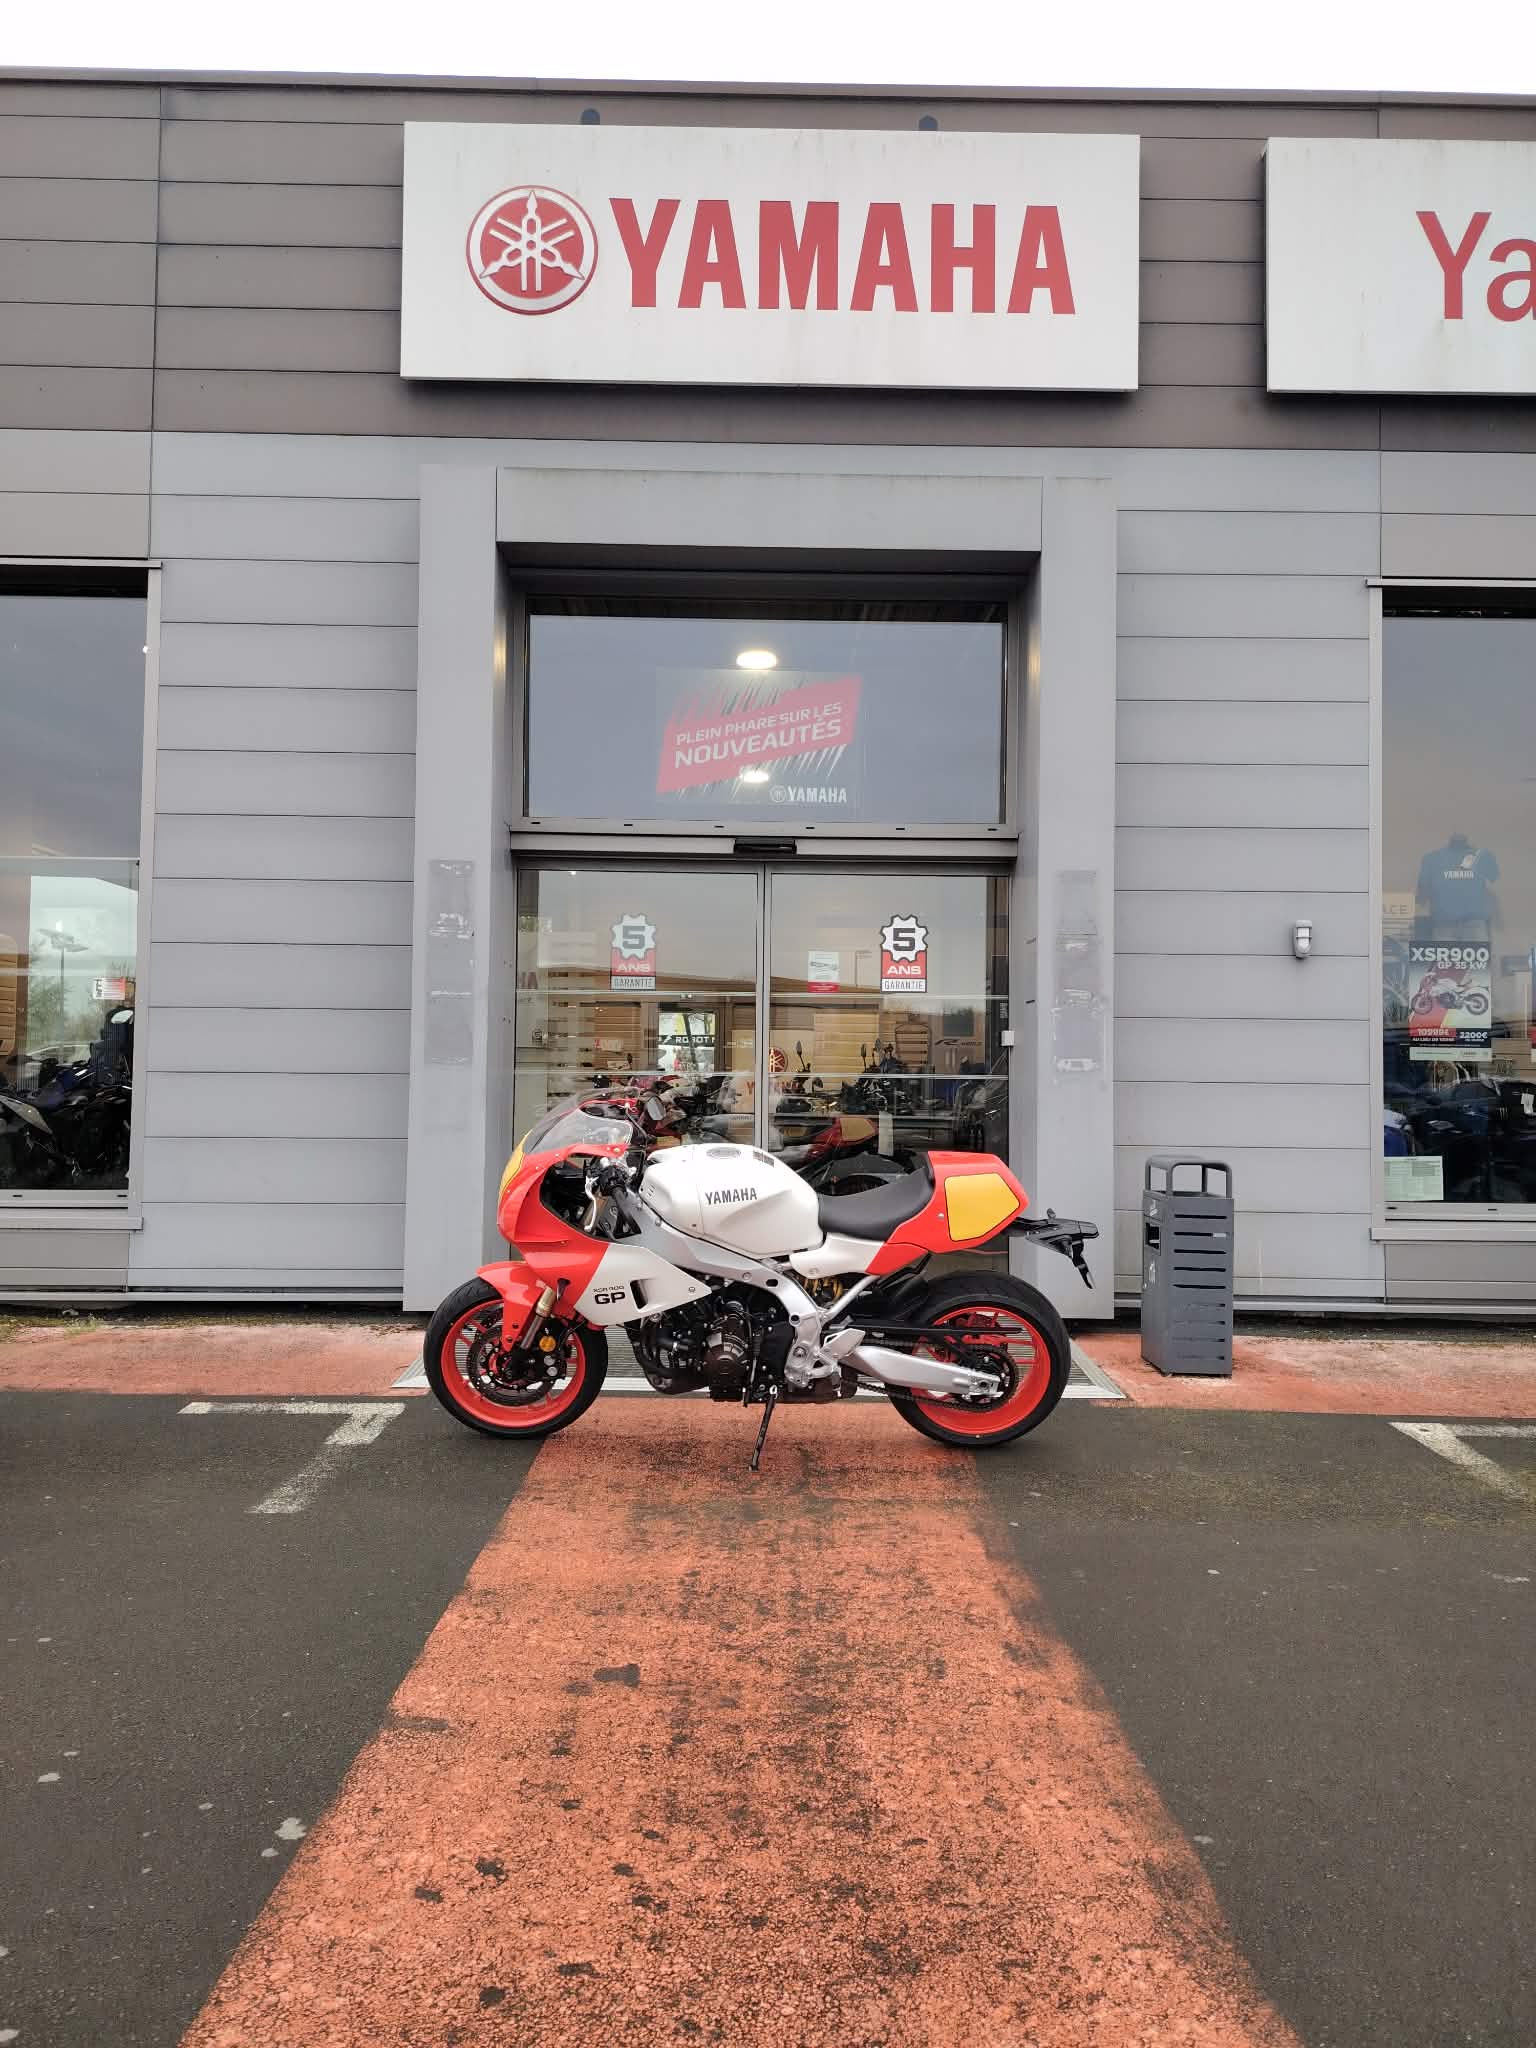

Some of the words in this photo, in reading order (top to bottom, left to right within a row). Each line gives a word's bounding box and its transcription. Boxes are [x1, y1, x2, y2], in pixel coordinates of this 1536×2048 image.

[609, 198, 1075, 314] YAMAHA
[1416, 210, 1536, 322] Ya
[676, 728, 721, 746] PLEIN
[725, 715, 776, 737] PHARE
[779, 708, 809, 724] SUR
[813, 702, 842, 718] LES
[674, 717, 841, 769] NOUVEAUTÉS
[787, 785, 847, 803] YAMAHA
[622, 925, 646, 950] 5
[893, 927, 916, 951] 5
[1411, 947, 1489, 962] XSR900
[616, 963, 650, 973] ANS
[887, 965, 922, 975] ANS
[614, 978, 654, 990] GARANTIE
[884, 980, 925, 990] GARANTIE
[705, 1187, 758, 1206] YAMAHA
[595, 1291, 626, 1304] GP
